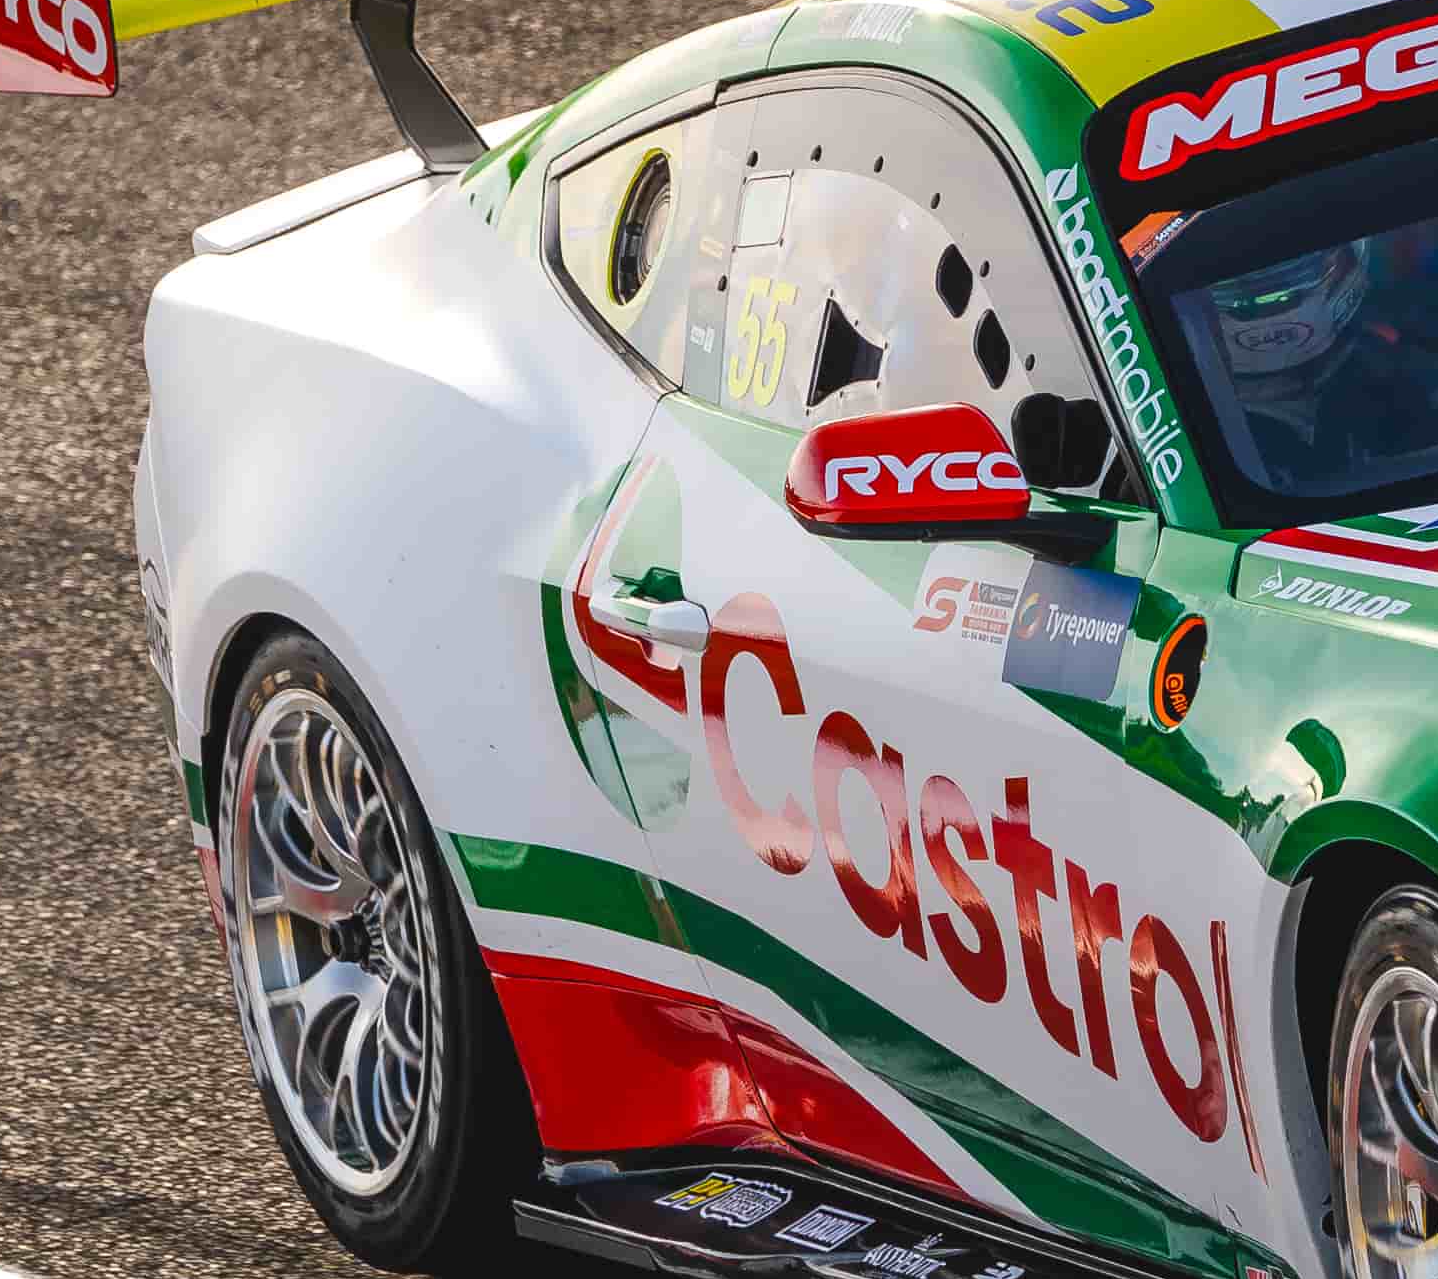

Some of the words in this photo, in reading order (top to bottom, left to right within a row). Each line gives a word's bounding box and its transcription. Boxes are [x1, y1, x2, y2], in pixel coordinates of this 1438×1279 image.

[727, 275, 798, 408] 55
[824, 450, 1029, 503] RYCO
[1278, 576, 1413, 620] DUNLOP
[1045, 603, 1126, 647] Tyrepower
[700, 591, 1269, 1188] Castrol
